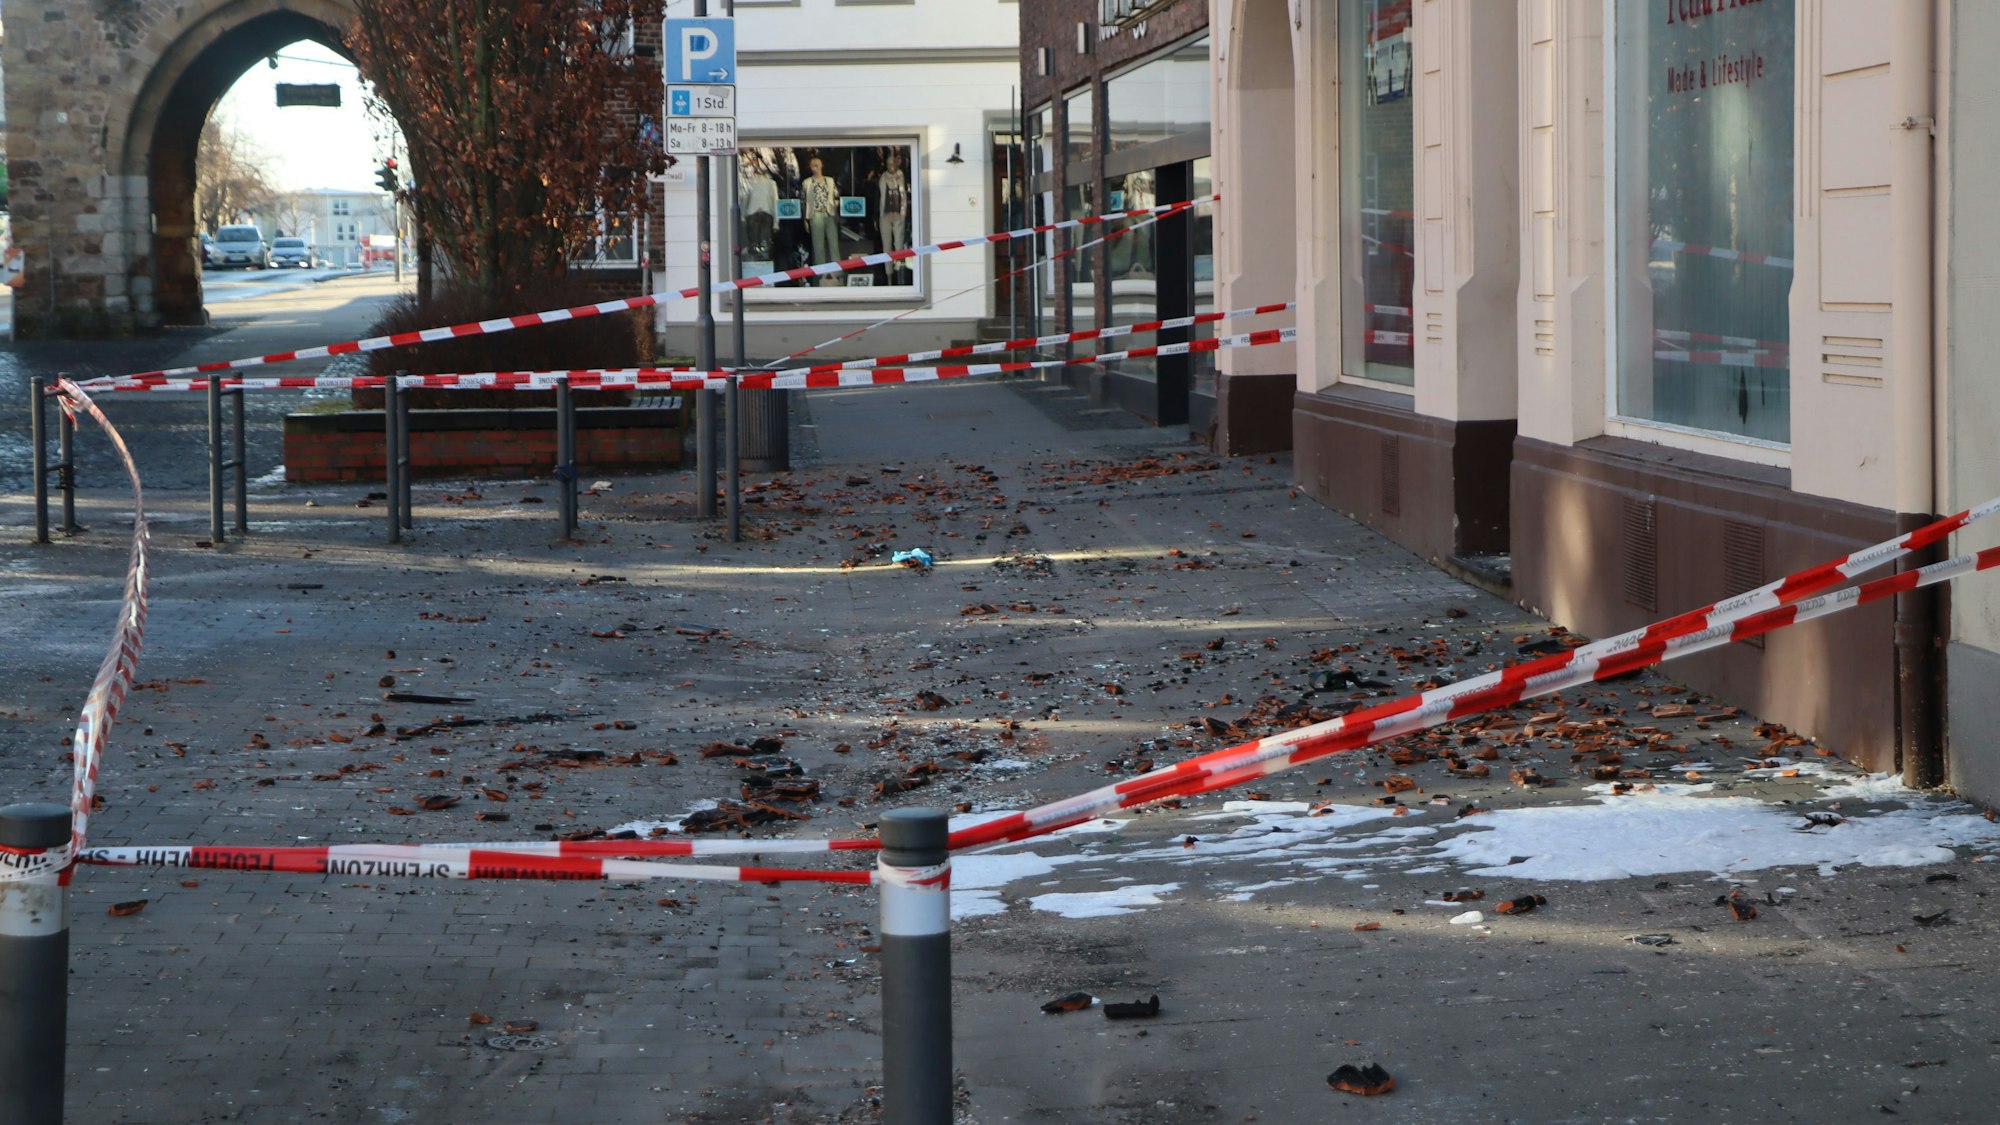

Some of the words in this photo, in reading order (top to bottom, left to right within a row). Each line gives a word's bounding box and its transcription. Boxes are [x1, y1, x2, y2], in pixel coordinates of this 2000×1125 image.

[681, 27, 718, 80] P
[1667, 63, 1694, 94] Mode
[1700, 60, 1706, 88] &
[1712, 49, 1763, 88] Lifestyle
[696, 97, 700, 108] 1
[670, 123, 696, 133] Mo-Fr
[702, 123, 707, 132] 8
[715, 123, 725, 132] 18
[727, 123, 732, 132] h
[670, 138, 681, 148] Sa
[702, 138, 707, 148] 8
[716, 138, 725, 148] 13
[727, 139, 732, 148] h
[316, 859, 450, 879] SPERRZONE
